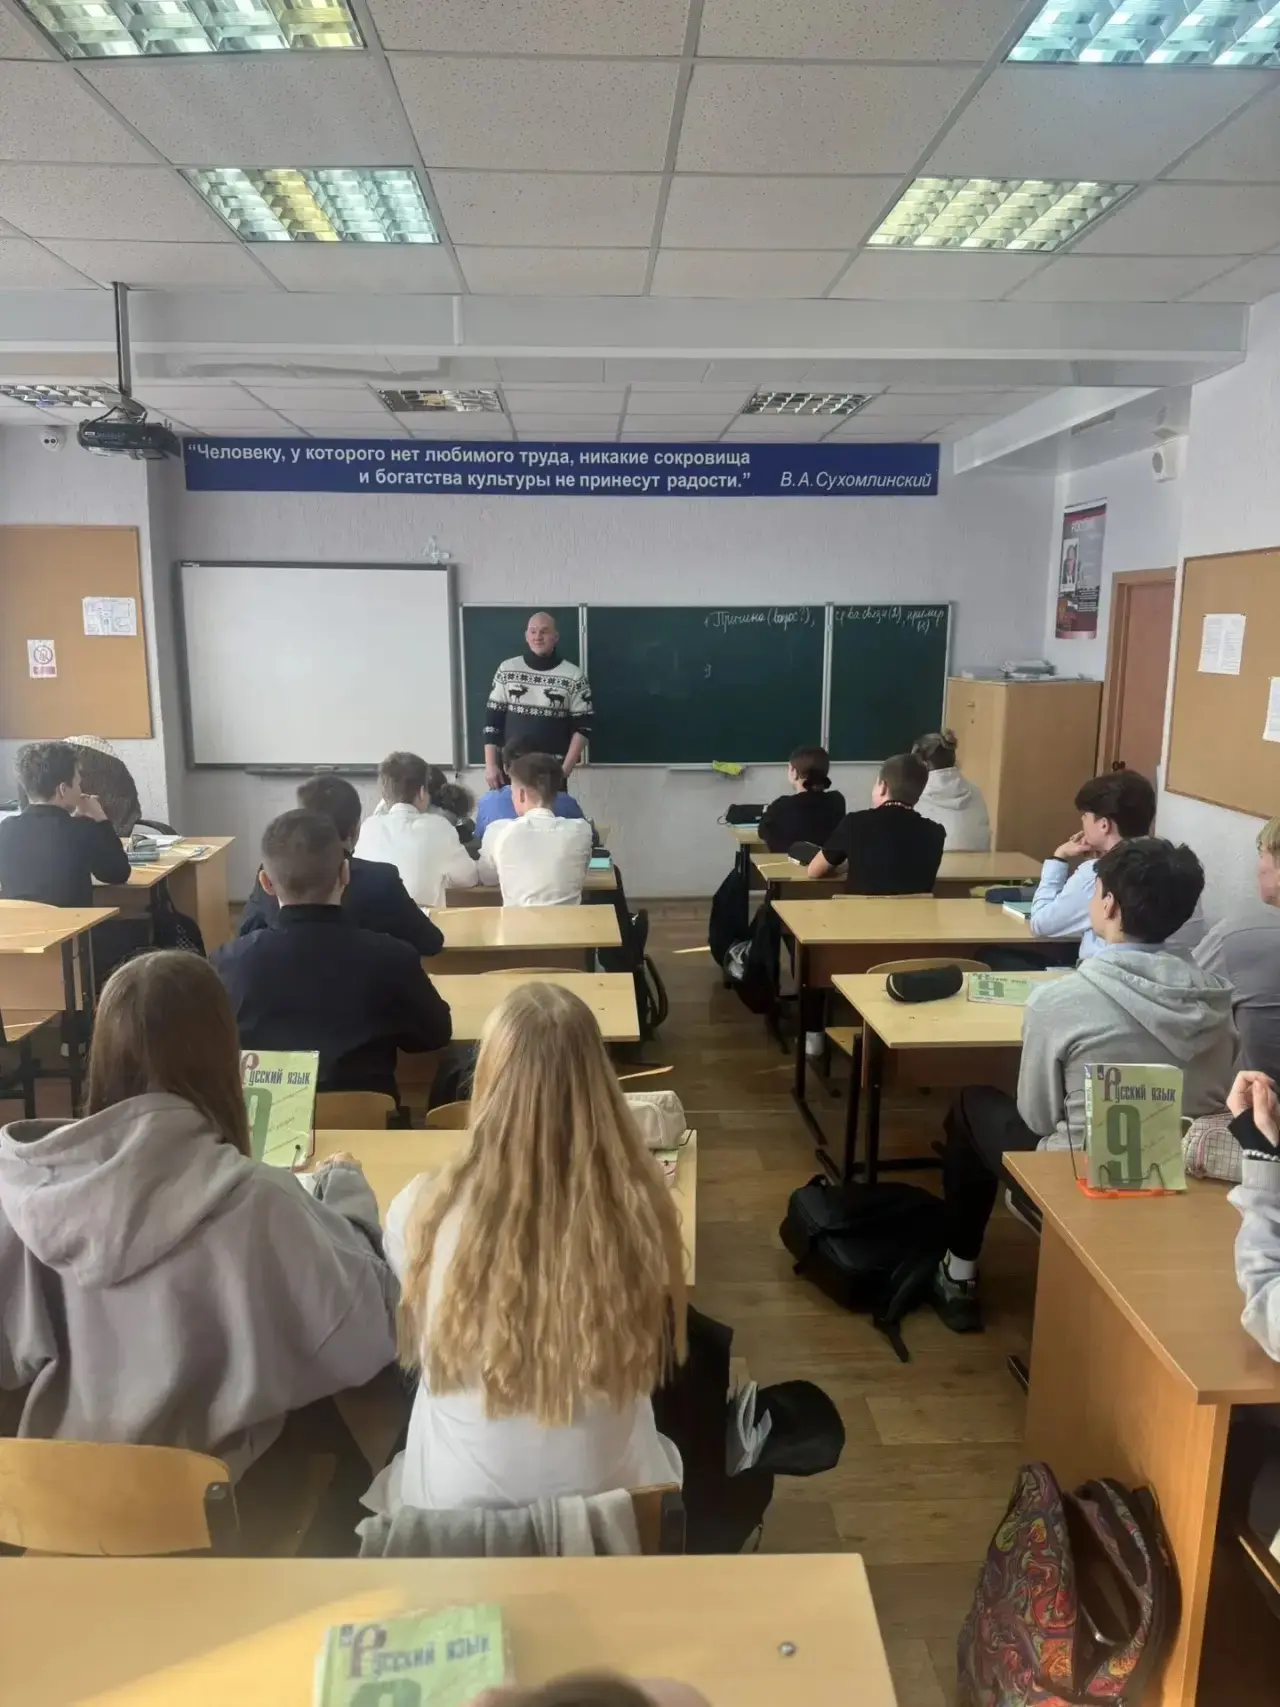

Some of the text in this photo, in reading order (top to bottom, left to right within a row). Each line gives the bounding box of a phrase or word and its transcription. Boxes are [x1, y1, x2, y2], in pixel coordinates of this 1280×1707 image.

[291, 448, 300, 464] у
[305, 447, 386, 464] которого
[391, 448, 420, 462] нет
[425, 446, 515, 464] любимого
[519, 449, 575, 466] труда,
[579, 450, 649, 465] никакие
[653, 451, 751, 468] сокровища
[359, 471, 370, 484] и
[375, 468, 462, 486] богатства
[467, 473, 551, 489] культуры
[556, 474, 576, 488] не
[579, 474, 660, 490] принесут
[241, 1052, 311, 1086] Русский язык
[1102, 1067, 1177, 1103] Русский язык
[1107, 1104, 1142, 1189] 9
[349, 1624, 491, 1679] Русский язык
